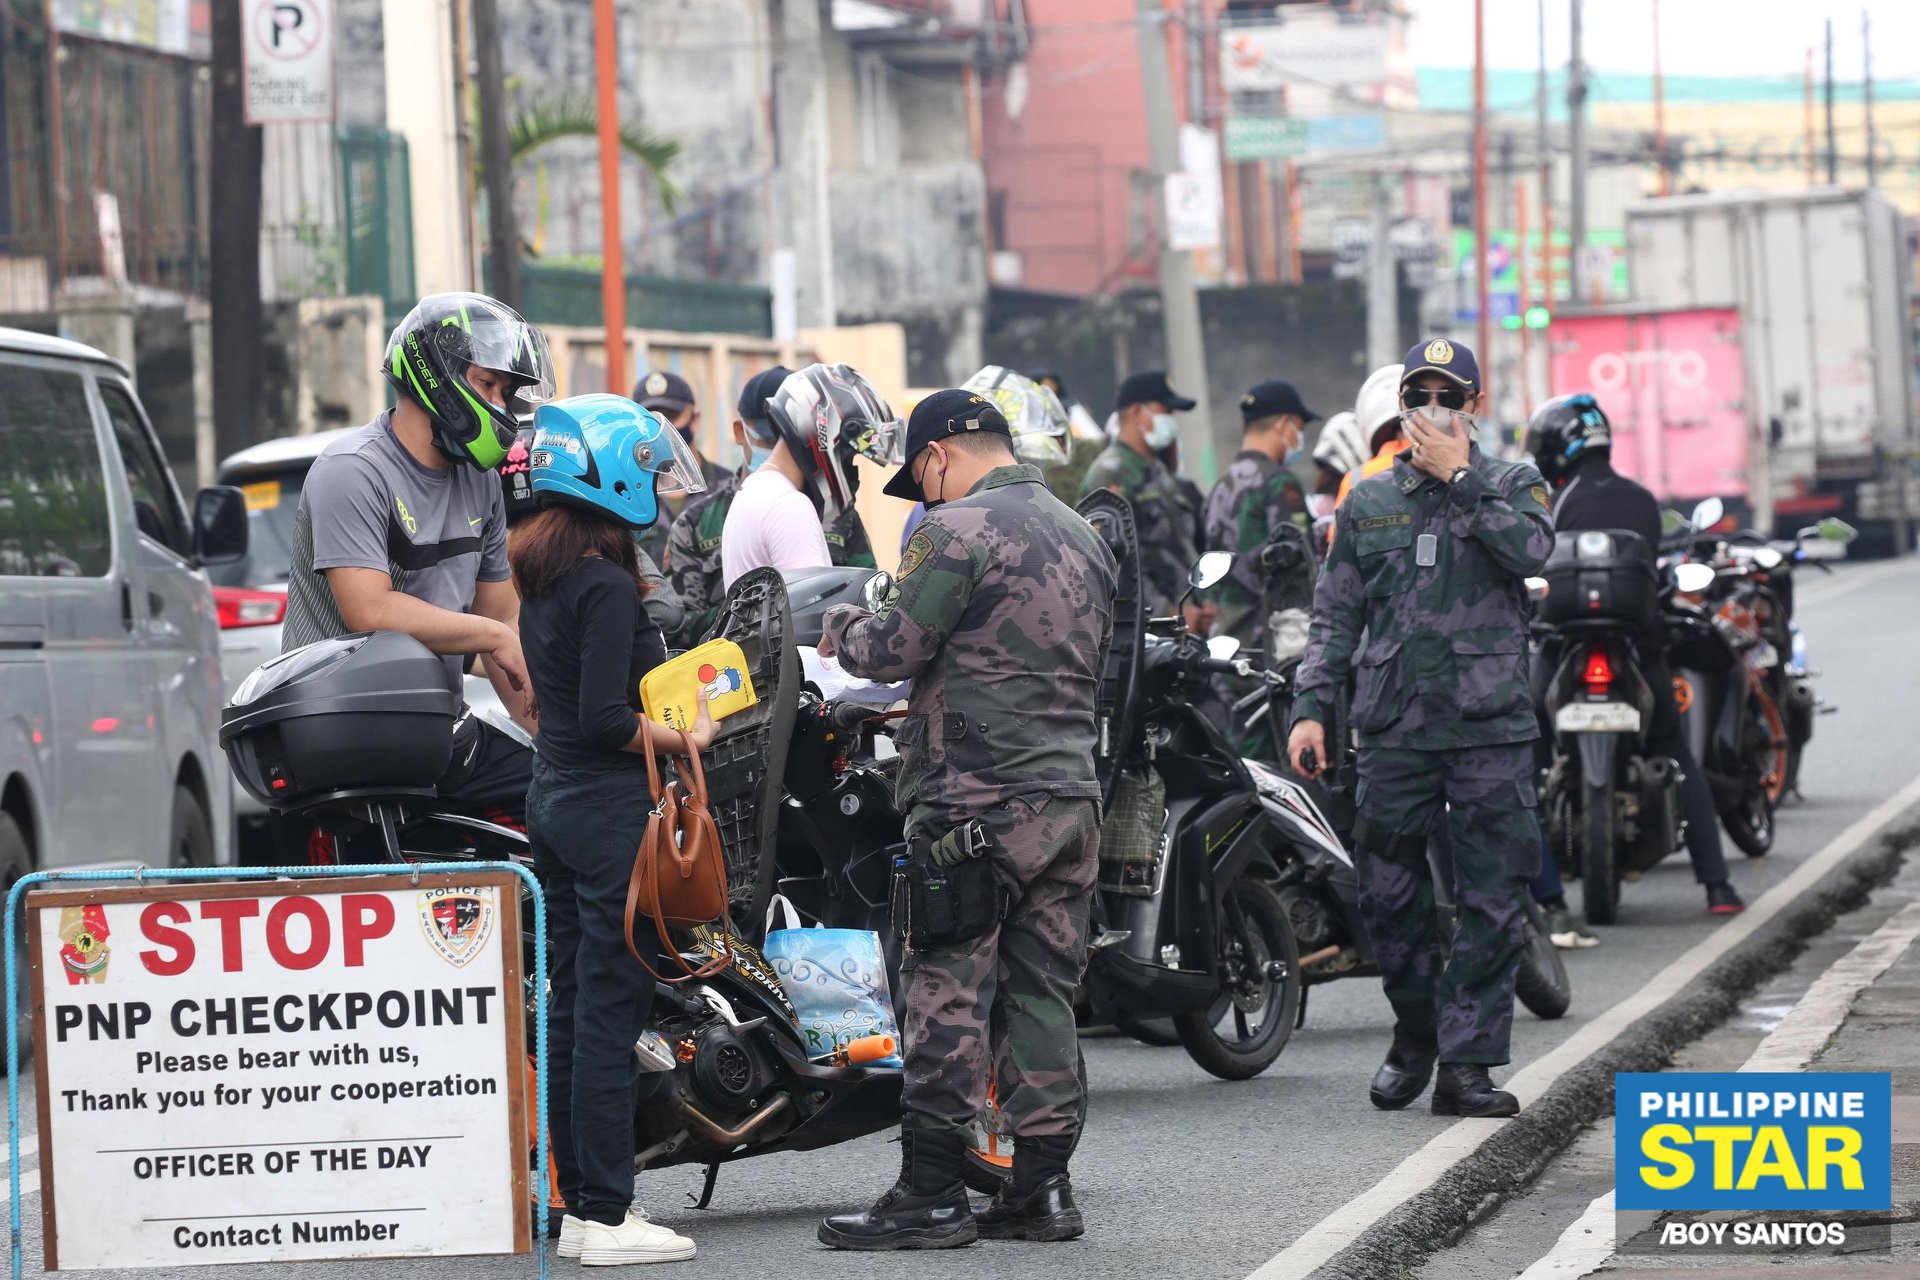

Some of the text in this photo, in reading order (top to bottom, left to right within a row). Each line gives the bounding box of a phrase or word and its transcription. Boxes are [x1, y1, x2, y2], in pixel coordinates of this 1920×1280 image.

[407, 331, 439, 390] SPYDER
[1588, 350, 1708, 392] OTTO
[426, 887, 482, 900] POLICE
[138, 894, 396, 976] STOP
[55, 986, 497, 1043] PNP CHECKPOINT
[136, 1042, 419, 1074] Please bear with us,
[61, 1073, 497, 1114] Thank you for your cooperation
[132, 1145, 432, 1180] OFFICER OF THE DAY
[173, 1219, 400, 1249] Contact Number
